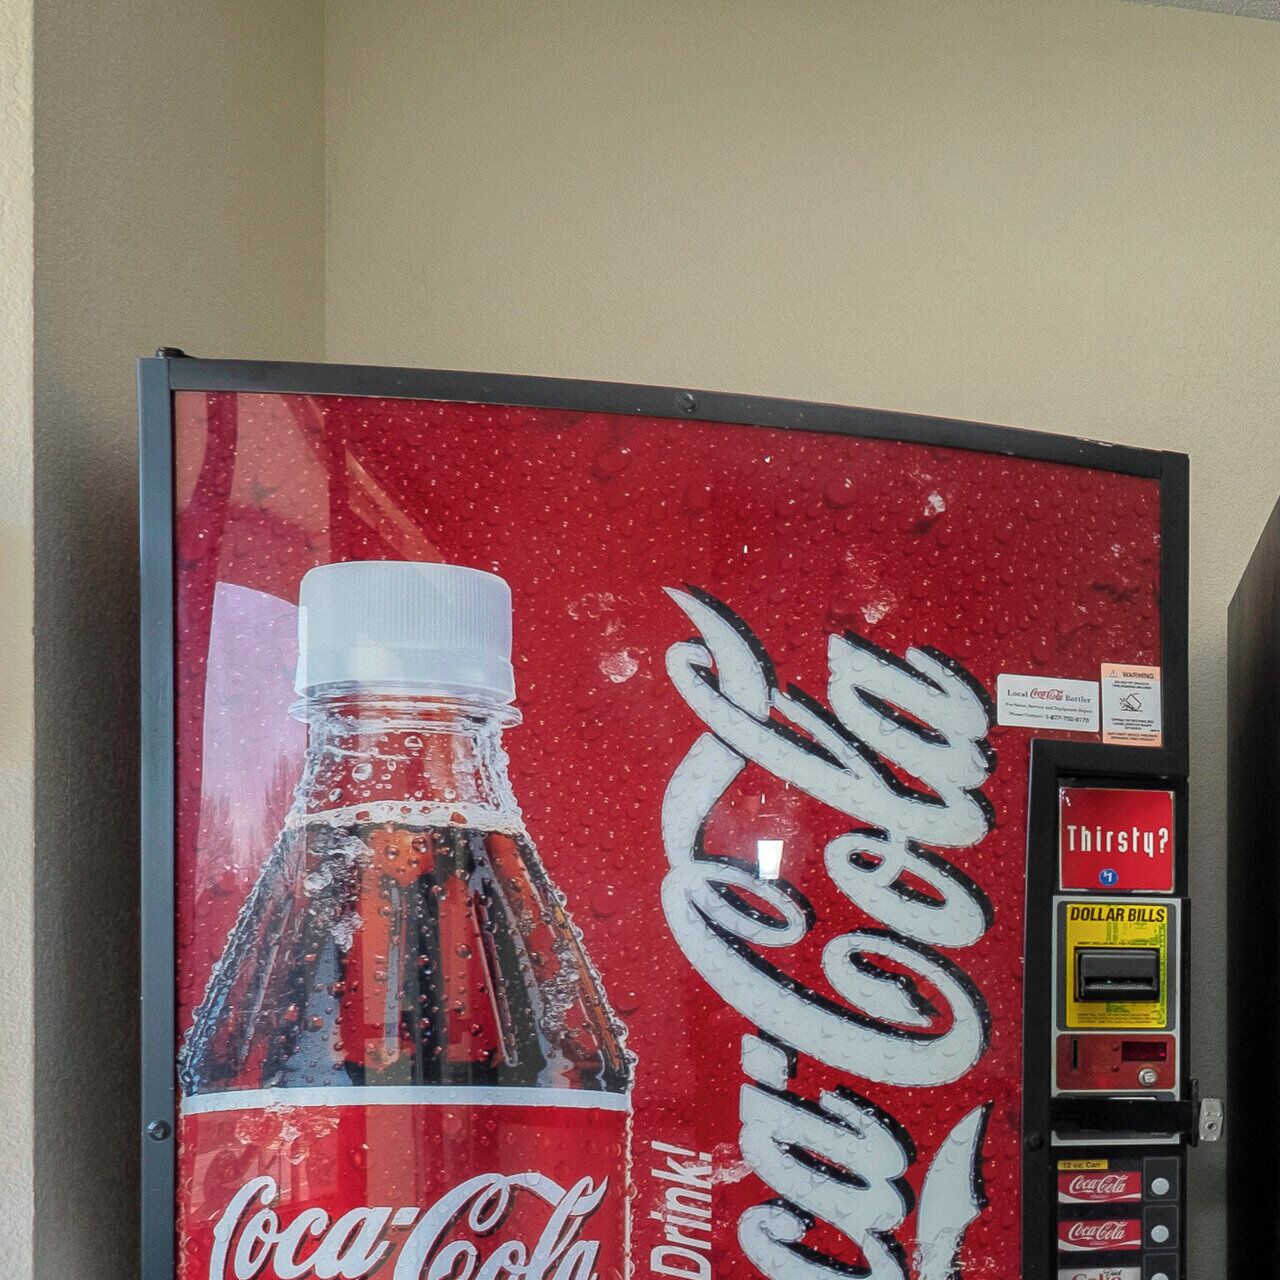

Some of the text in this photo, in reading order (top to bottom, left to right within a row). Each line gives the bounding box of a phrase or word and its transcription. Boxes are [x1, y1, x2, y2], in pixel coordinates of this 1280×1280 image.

[1007, 689, 1028, 698] Local
[1065, 694, 1091, 704] Bottler
[1067, 825, 1169, 858] Thirsty?
[1070, 907, 1166, 922] DOLLAR BILLS
[1069, 1174, 1129, 1194] Coca-Cola
[1069, 1221, 1128, 1241] Coca-Cola
